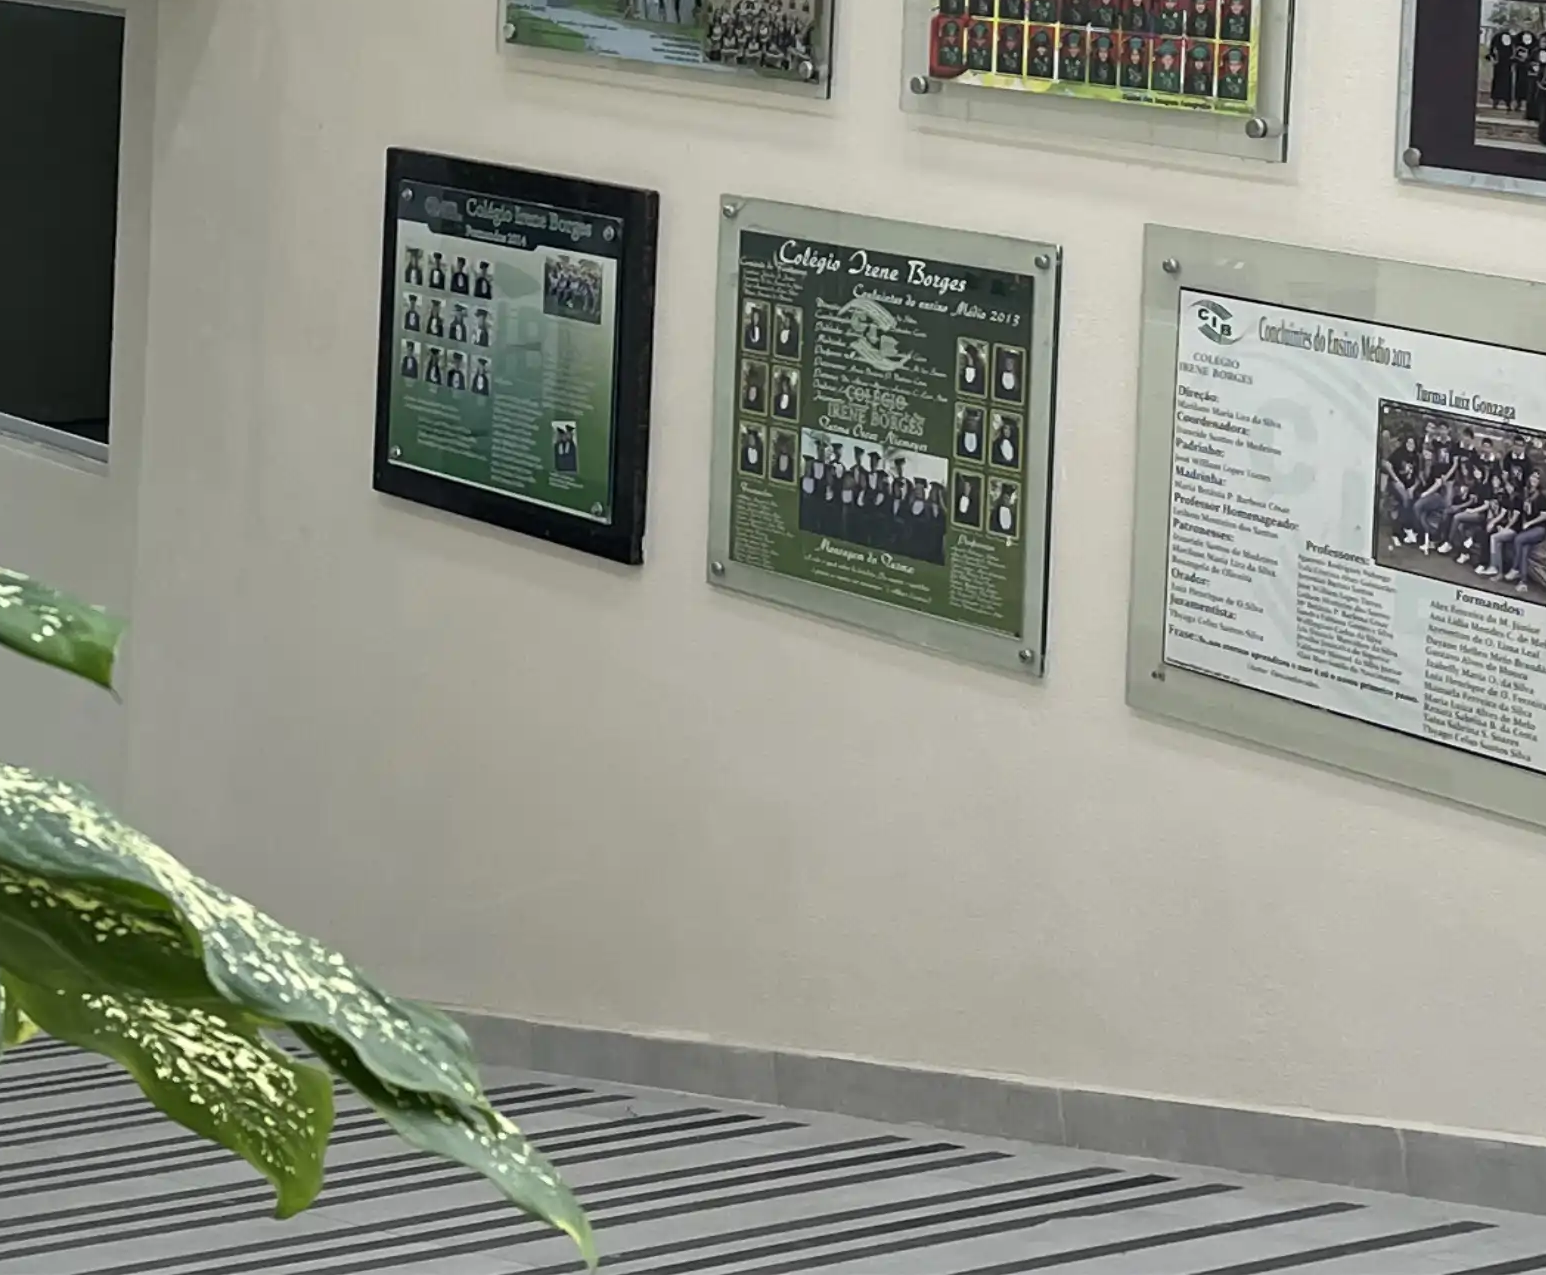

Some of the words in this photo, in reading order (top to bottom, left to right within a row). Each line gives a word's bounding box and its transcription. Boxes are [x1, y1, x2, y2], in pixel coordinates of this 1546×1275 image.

[466, 197, 513, 226] Colégio
[549, 212, 592, 241] Borges
[779, 240, 841, 272] Colégio
[848, 250, 899, 282] Irene
[907, 260, 967, 294] Borges
[990, 309, 1021, 326] 2013
[1198, 308, 1232, 336] CIB
[1313, 334, 1325, 353] do
[1327, 329, 1358, 359] Ensino
[1361, 335, 1390, 365] Médio
[1179, 385, 1219, 403] Direção:
[1416, 382, 1446, 406] Turma
[1472, 395, 1516, 420] Gonzaga
[1174, 492, 1220, 512] Professor
[1306, 540, 1370, 565] Professores:
